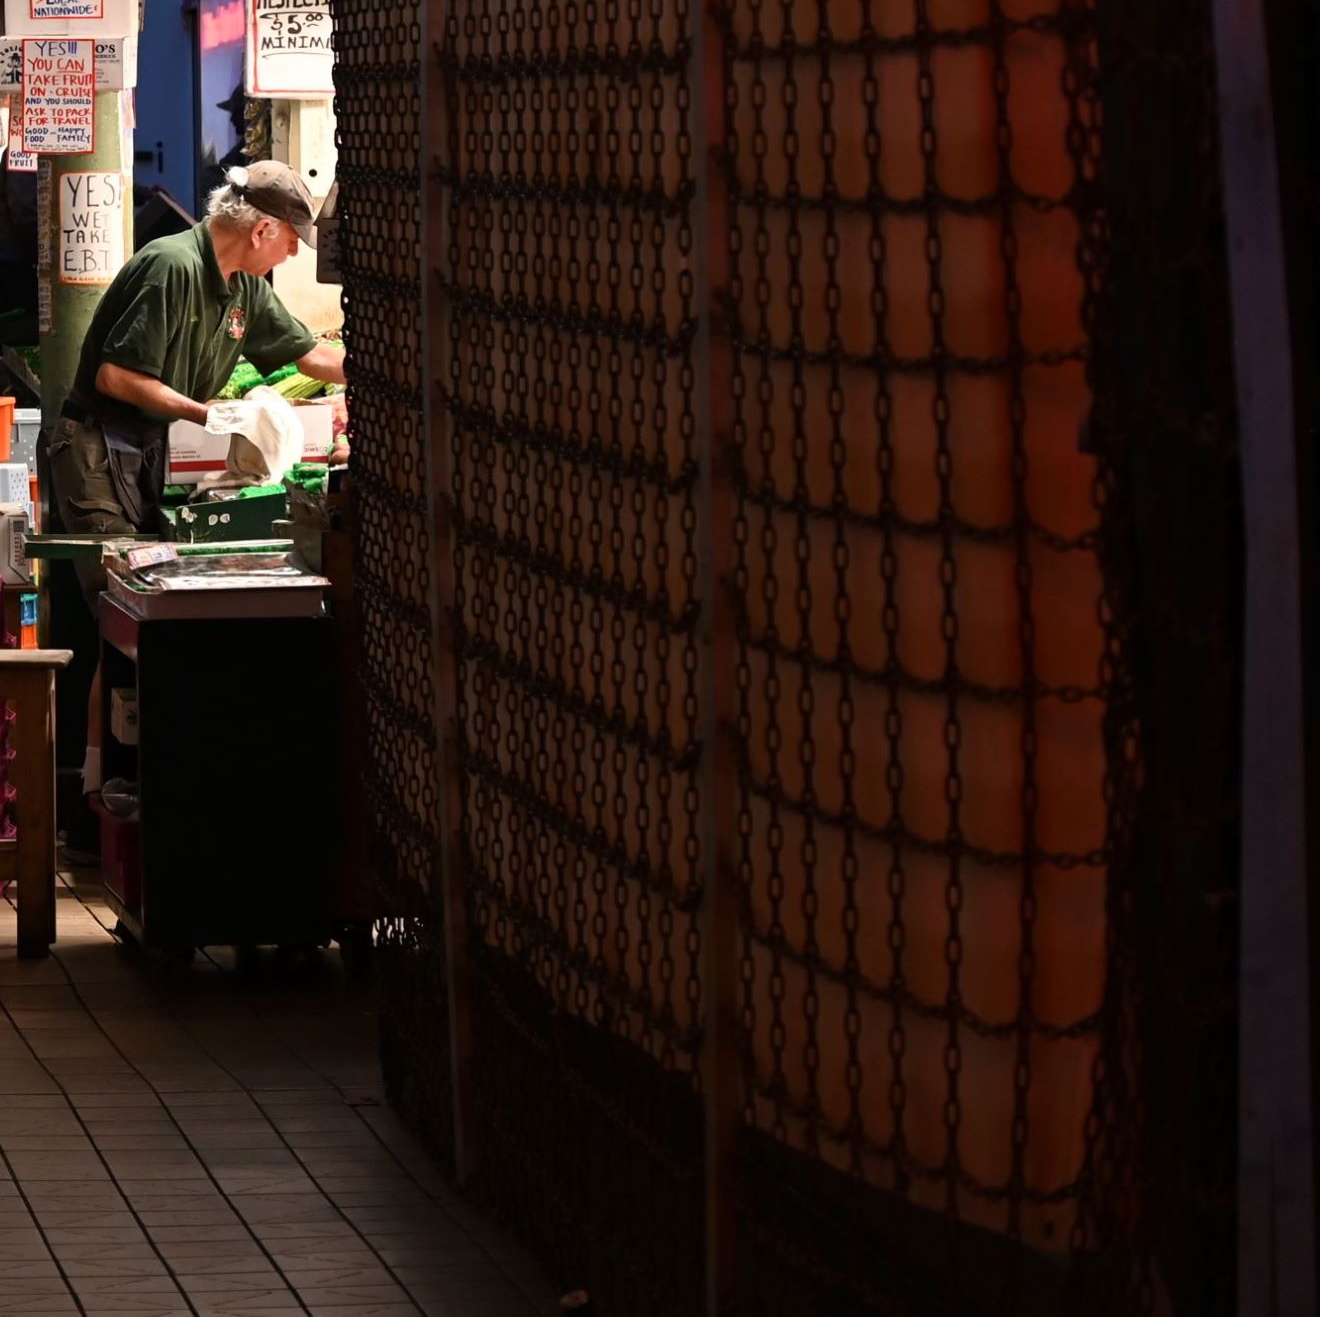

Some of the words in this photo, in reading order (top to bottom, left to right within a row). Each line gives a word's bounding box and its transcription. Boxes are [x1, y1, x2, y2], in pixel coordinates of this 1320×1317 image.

[34, 5, 93, 16] NATIONWIDE
[261, 35, 332, 51] MINIM
[95, 44, 116, 54] O'S
[27, 58, 52, 72] YOU
[57, 58, 85, 72] CAN
[26, 74, 59, 85] TAKE
[63, 74, 92, 85] FRUIT
[30, 87, 46, 96] ON
[55, 87, 91, 97] CRUISE
[25, 107, 46, 116] ASK
[51, 108, 63, 116] TO
[65, 108, 90, 116] PACK
[29, 117, 48, 126] FOR
[52, 117, 90, 125] TRAVEL
[25, 127, 48, 135] GOOD
[58, 127, 85, 135] HAPPY
[25, 135, 45, 143] FOOD
[57, 135, 90, 143] FAMILY
[10, 159, 33, 167] FRUIT
[63, 229, 111, 244] TAKE
